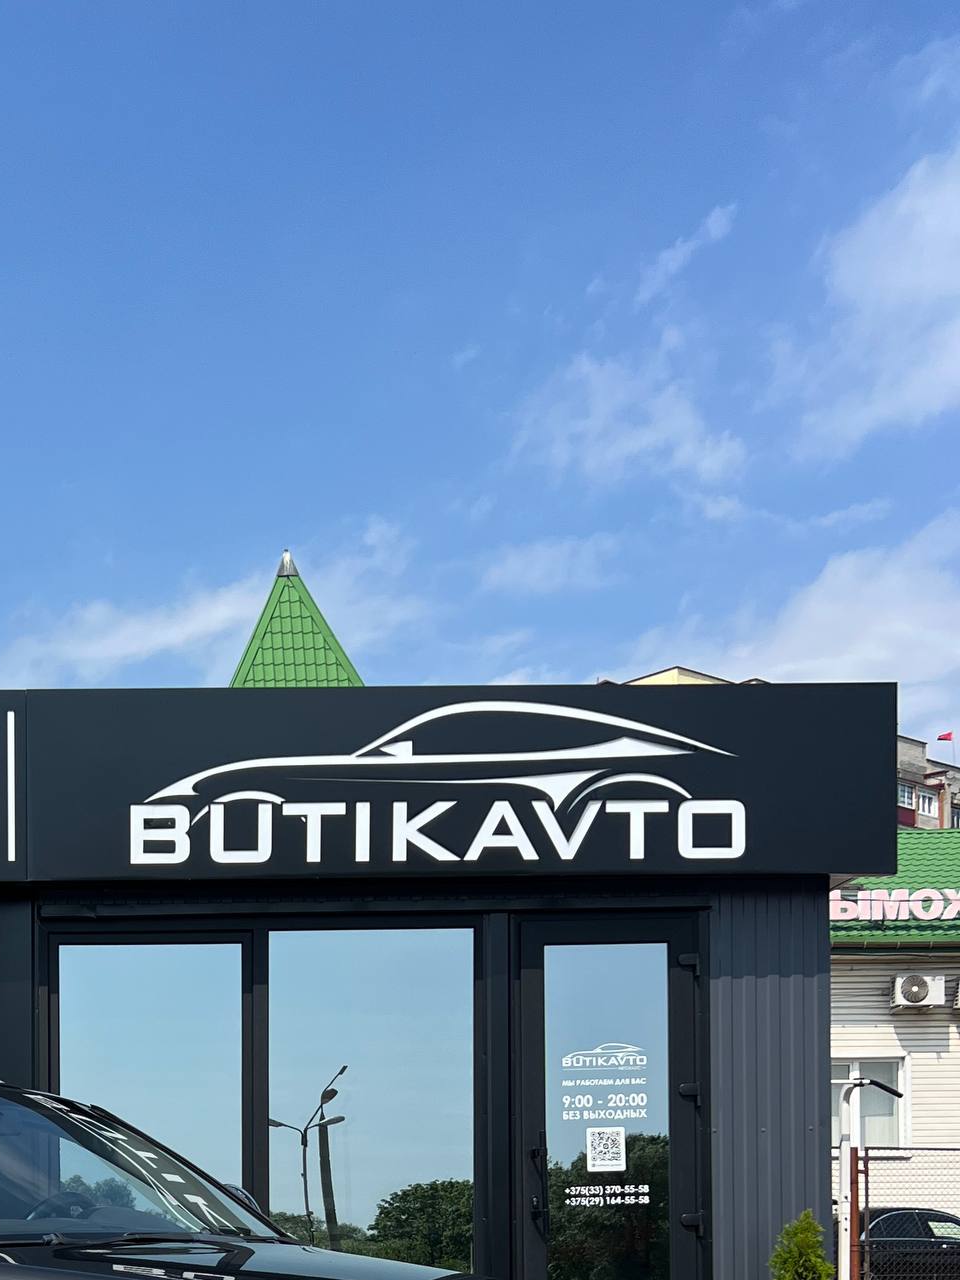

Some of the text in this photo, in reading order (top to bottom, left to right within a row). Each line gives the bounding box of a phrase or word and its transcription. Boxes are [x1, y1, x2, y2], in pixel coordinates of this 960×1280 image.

[129, 798, 747, 865] BUTIKAVTO
[561, 1055, 647, 1067] BUTIKAVTO
[562, 1094, 593, 1108] 9:00
[607, 1093, 648, 1107] 20:00
[562, 1108, 648, 1120] БЕЗ ВЫХОДНЫХ
[564, 1184, 650, 1196] +375(33) 370-55-58
[564, 1195, 650, 1207] +375(29) 164-55-58
